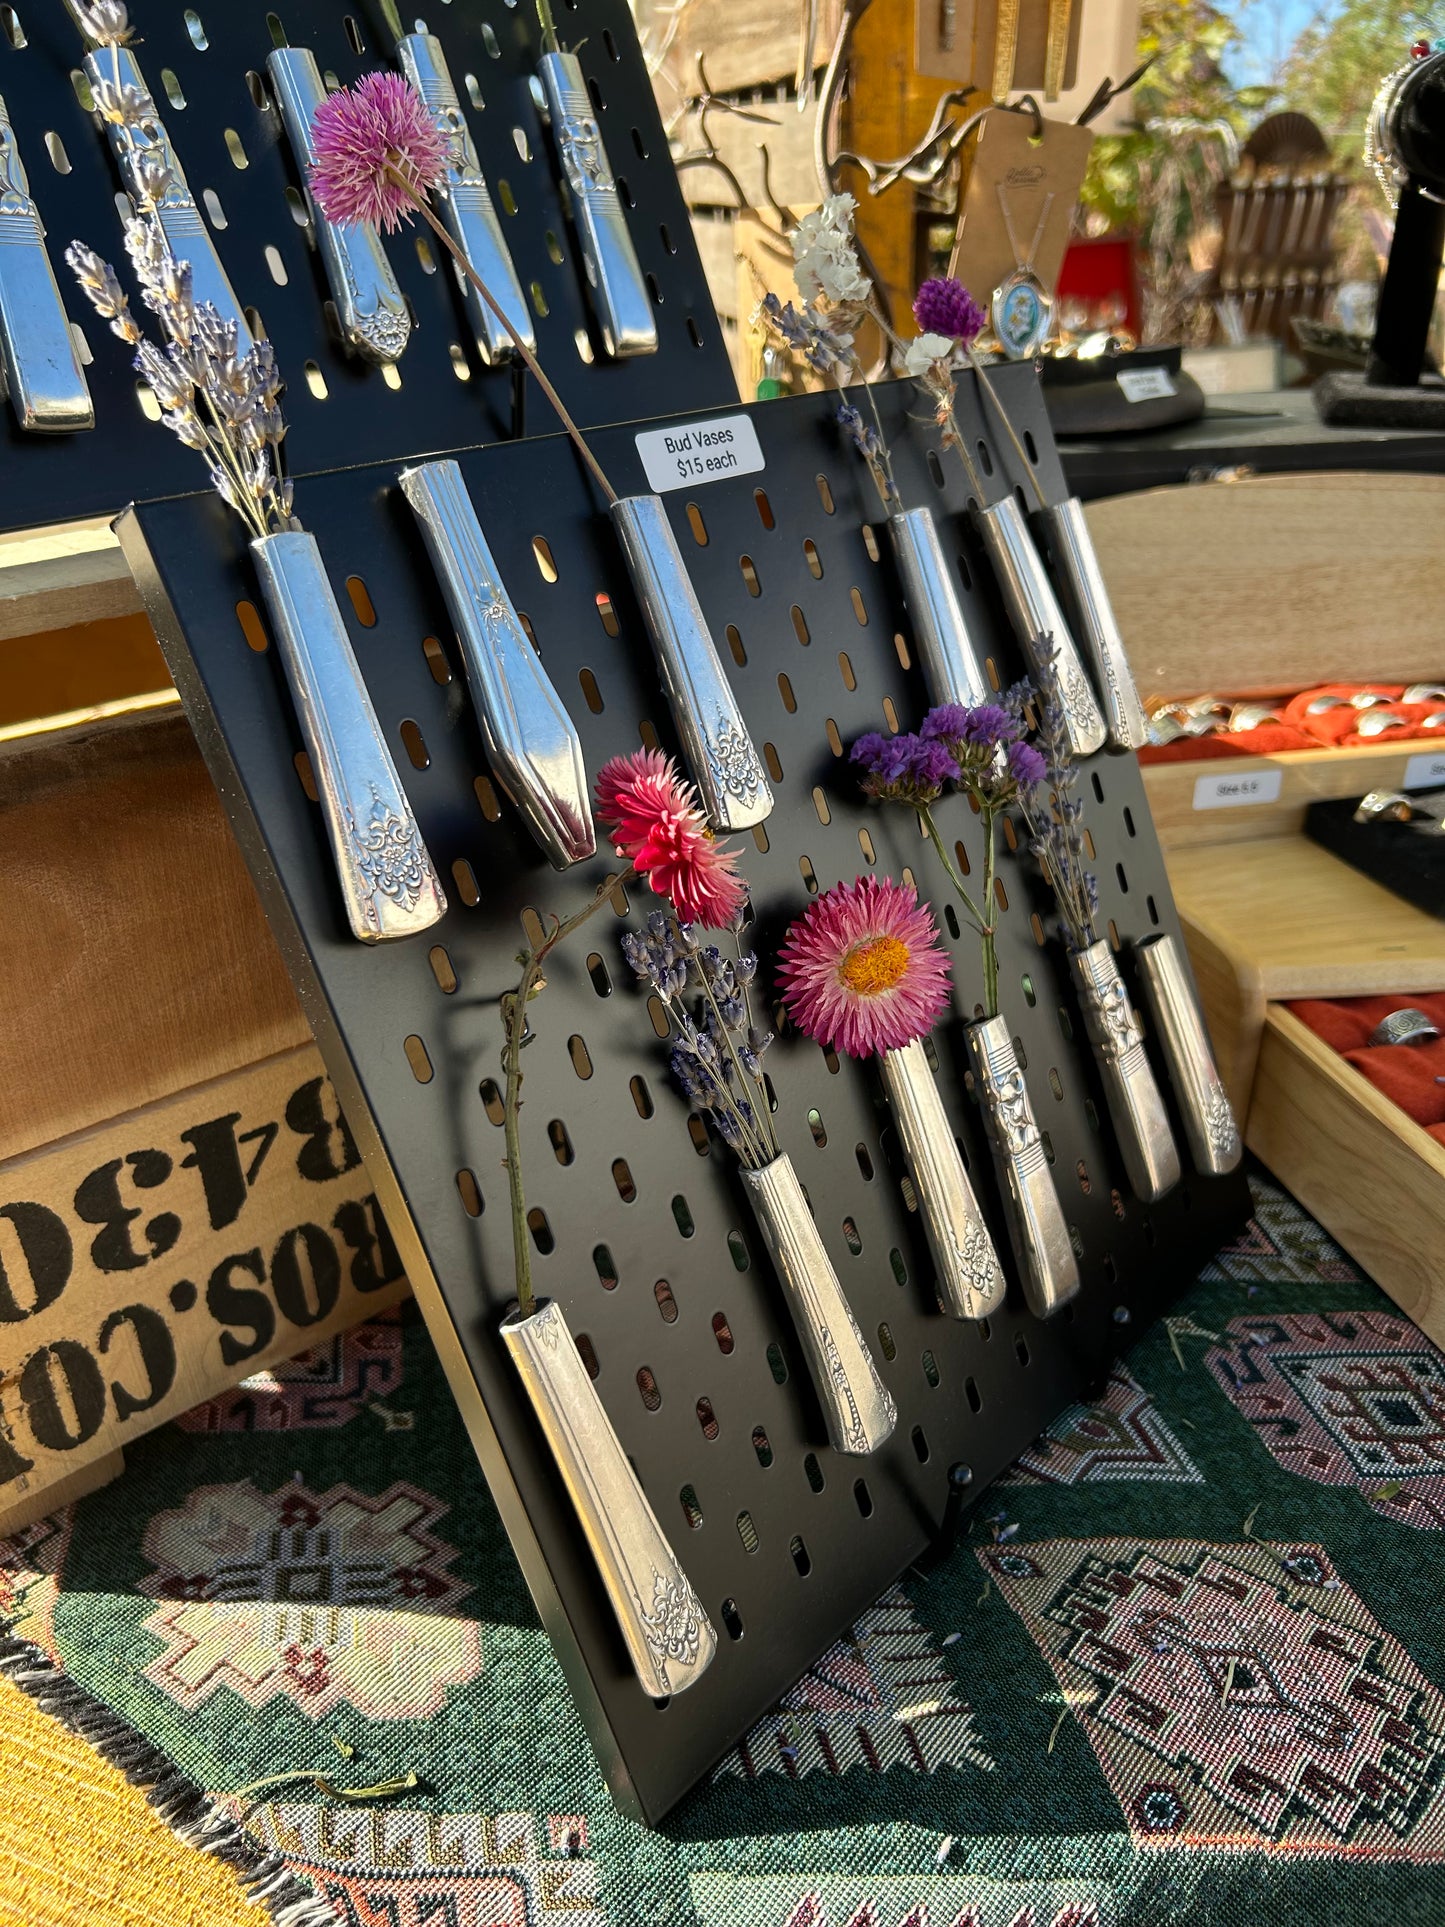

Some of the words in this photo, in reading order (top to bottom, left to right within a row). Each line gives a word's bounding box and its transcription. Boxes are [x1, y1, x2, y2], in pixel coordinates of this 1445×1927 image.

[664, 433, 692, 454] Bud
[693, 429, 734, 448] Vases
[677, 457, 704, 478] $15
[706, 451, 738, 472] each
